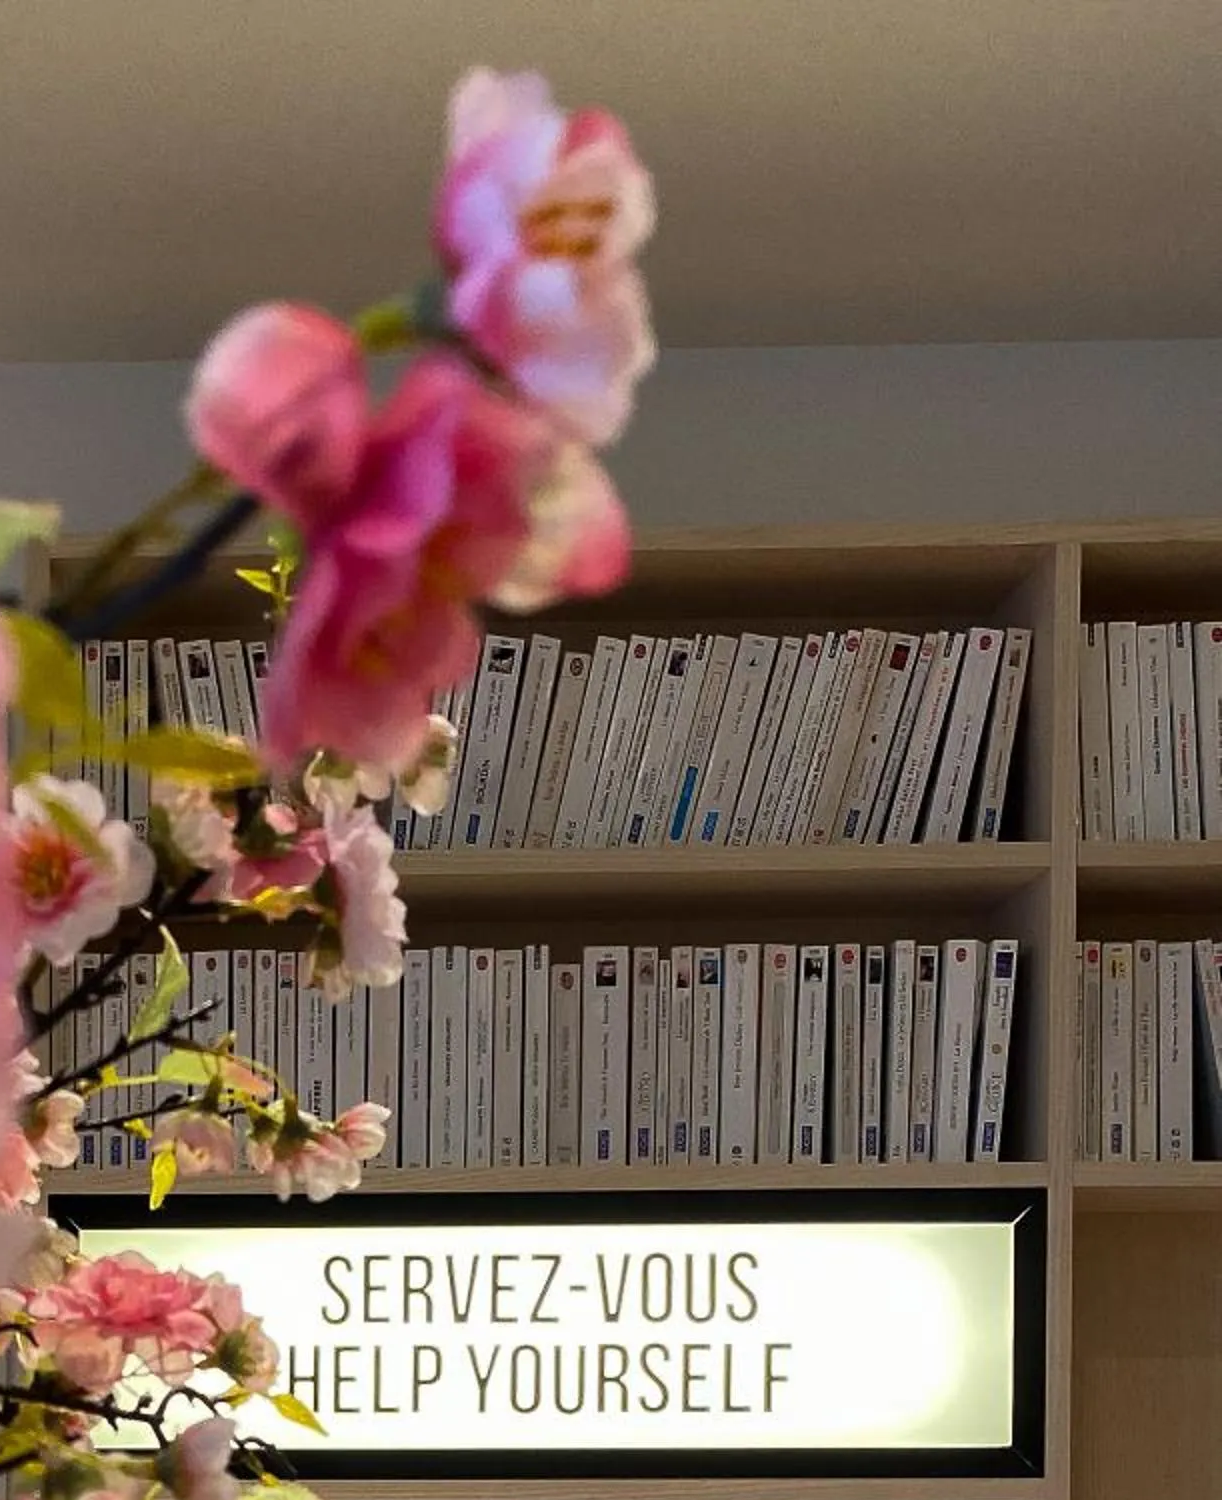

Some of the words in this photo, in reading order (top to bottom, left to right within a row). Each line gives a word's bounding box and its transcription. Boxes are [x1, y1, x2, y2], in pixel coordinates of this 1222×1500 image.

[321, 1251, 758, 1326] SERVEZ-VOUS
[289, 1344, 442, 1414] HELP
[466, 1342, 792, 1416] YOURSELF
